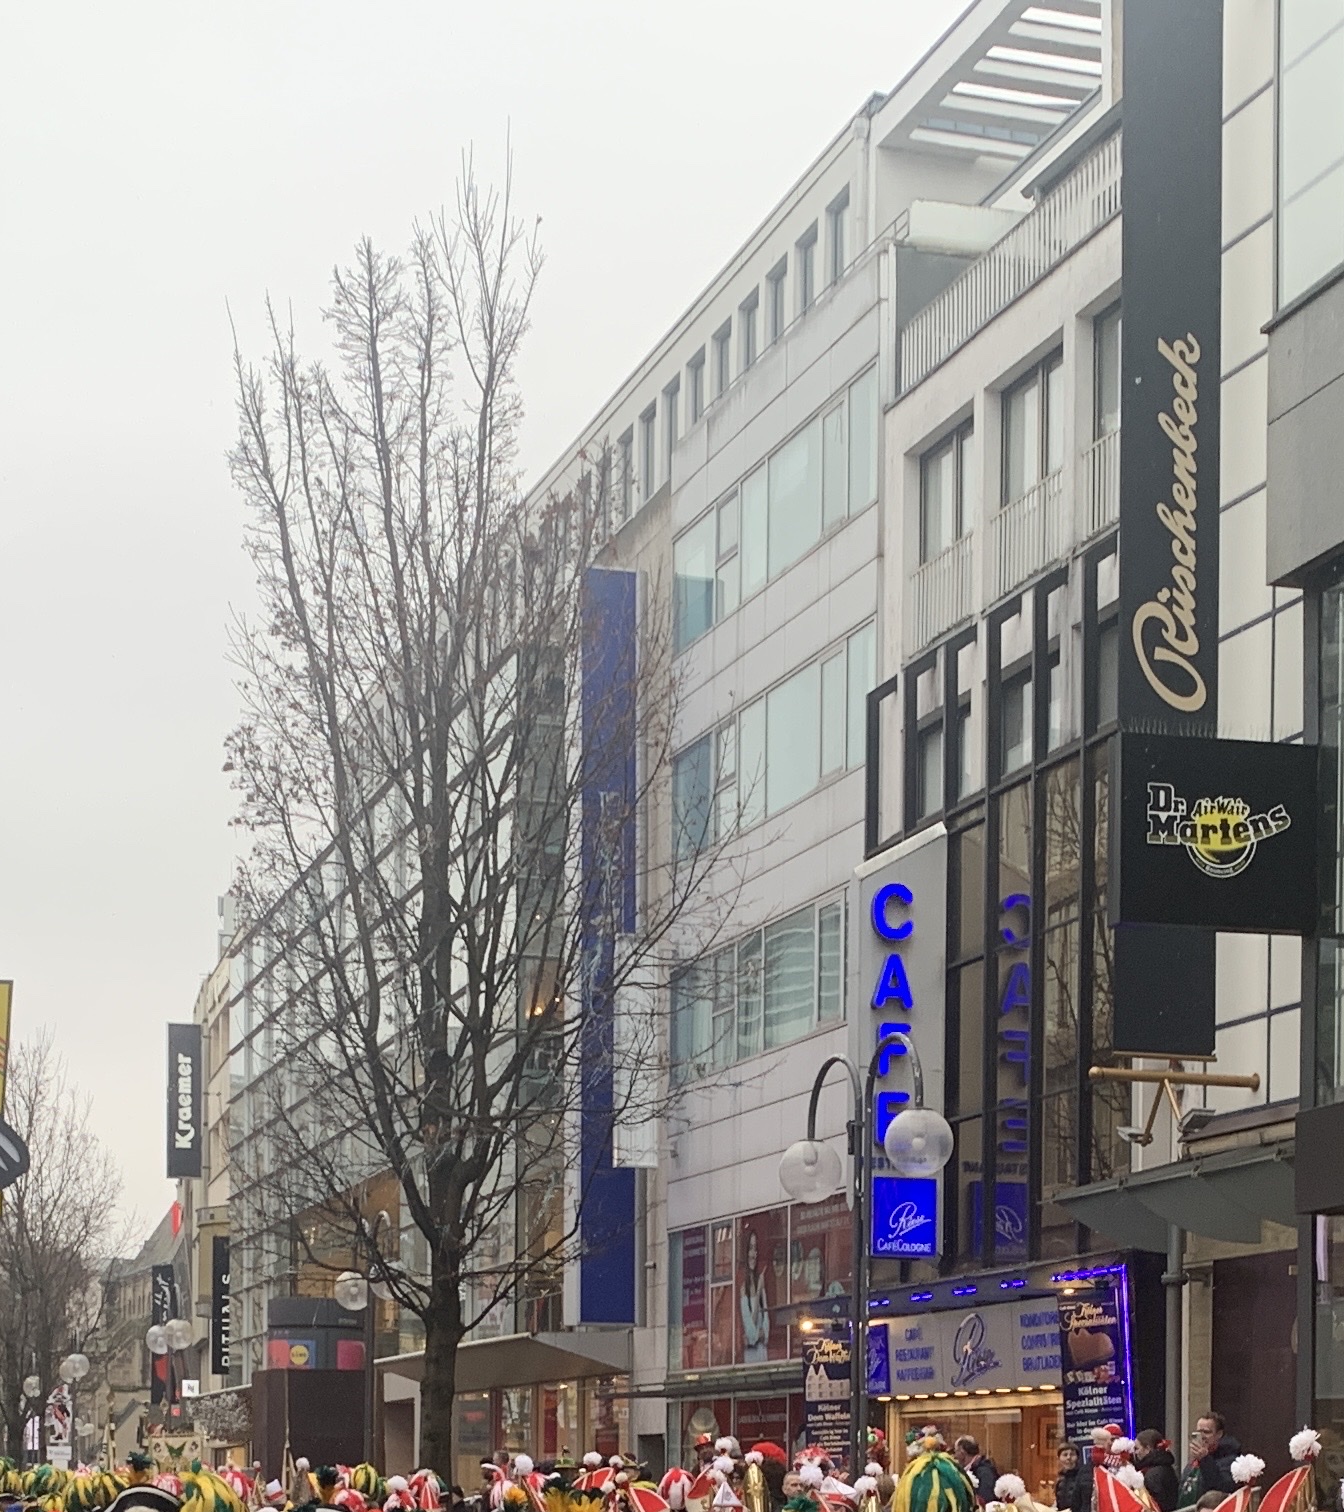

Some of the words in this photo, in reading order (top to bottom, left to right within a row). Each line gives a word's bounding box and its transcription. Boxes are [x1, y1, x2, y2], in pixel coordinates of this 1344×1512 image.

[1132, 332, 1207, 712] Rüschenbeck
[1147, 782, 1187, 816] Dr.
[1191, 796, 1250, 820] AirWair
[1147, 803, 1292, 846] Martens
[175, 1052, 193, 1150] Kraemer
[1065, 1396, 1122, 1410] Spezialitäten
[1078, 1385, 1109, 1397] Kölner
